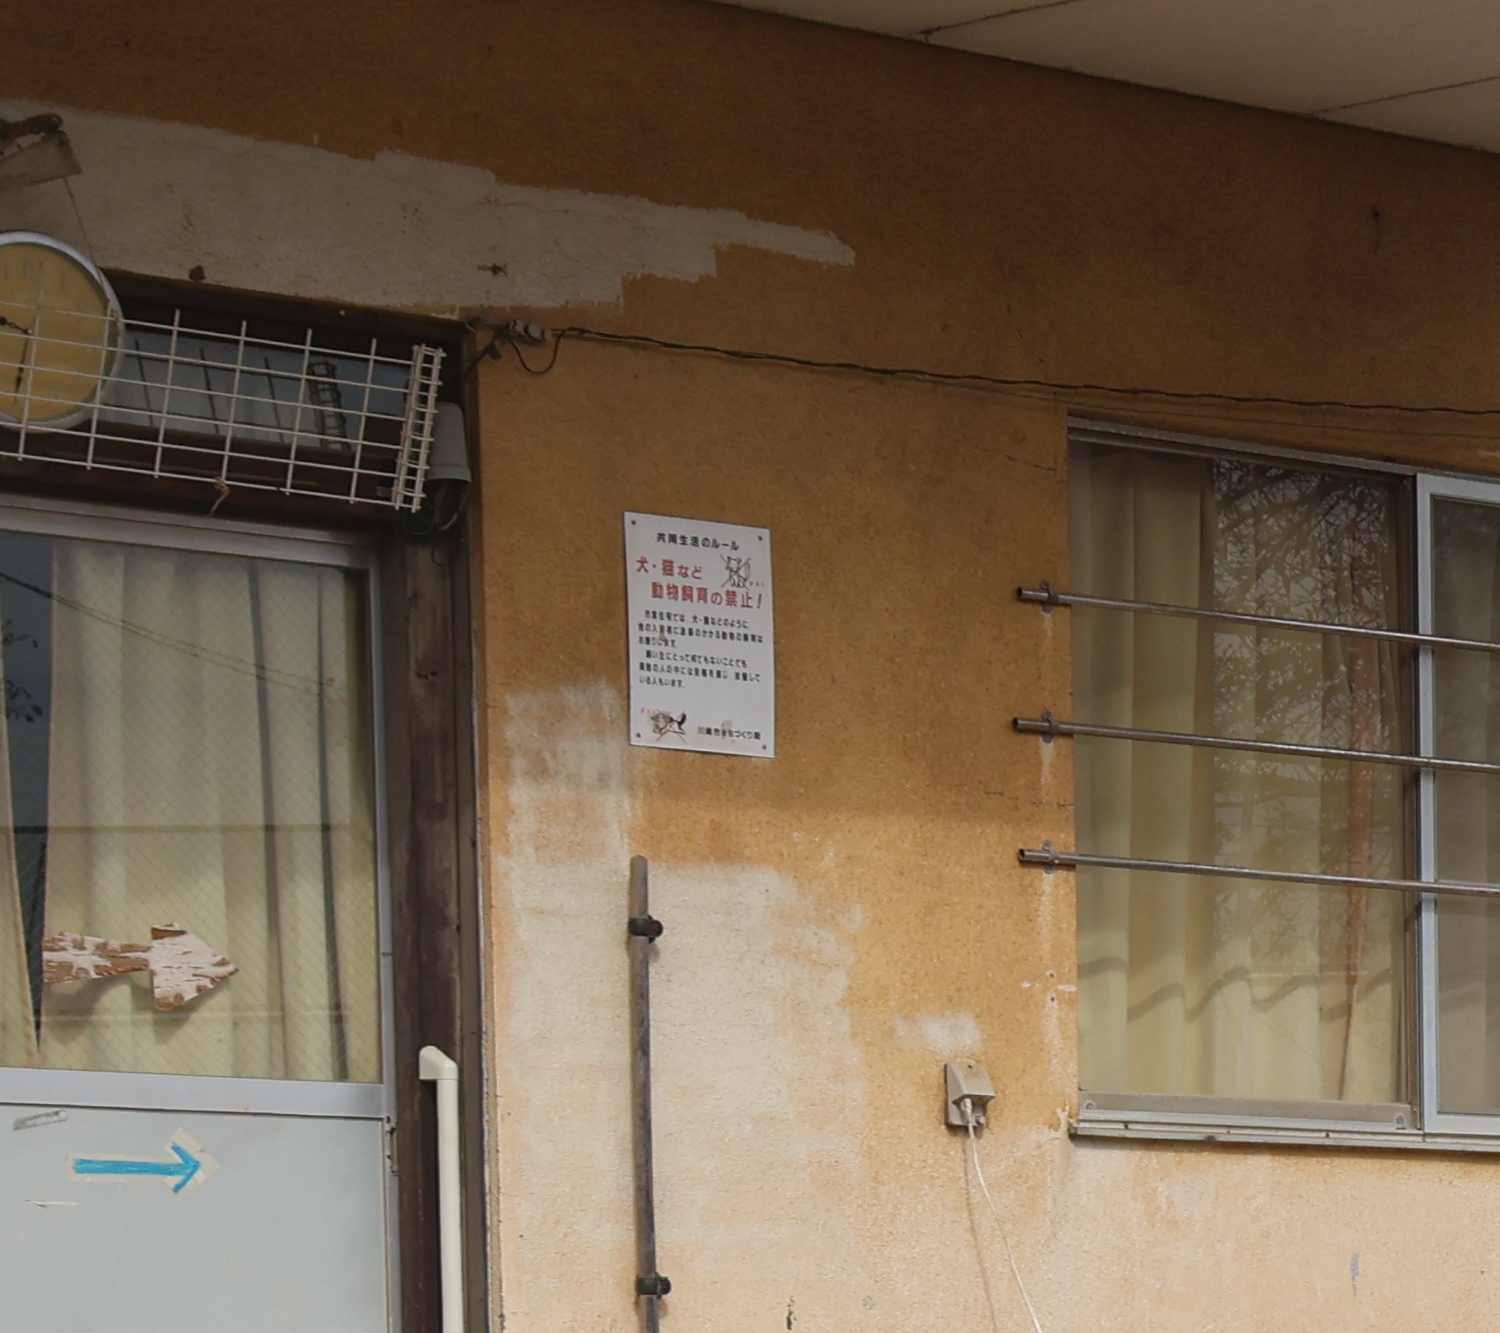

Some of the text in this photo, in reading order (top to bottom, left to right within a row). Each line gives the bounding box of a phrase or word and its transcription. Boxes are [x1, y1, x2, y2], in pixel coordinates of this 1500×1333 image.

[656, 532, 739, 551] 共同生活のルール
[636, 556, 703, 580] 犬・猫など
